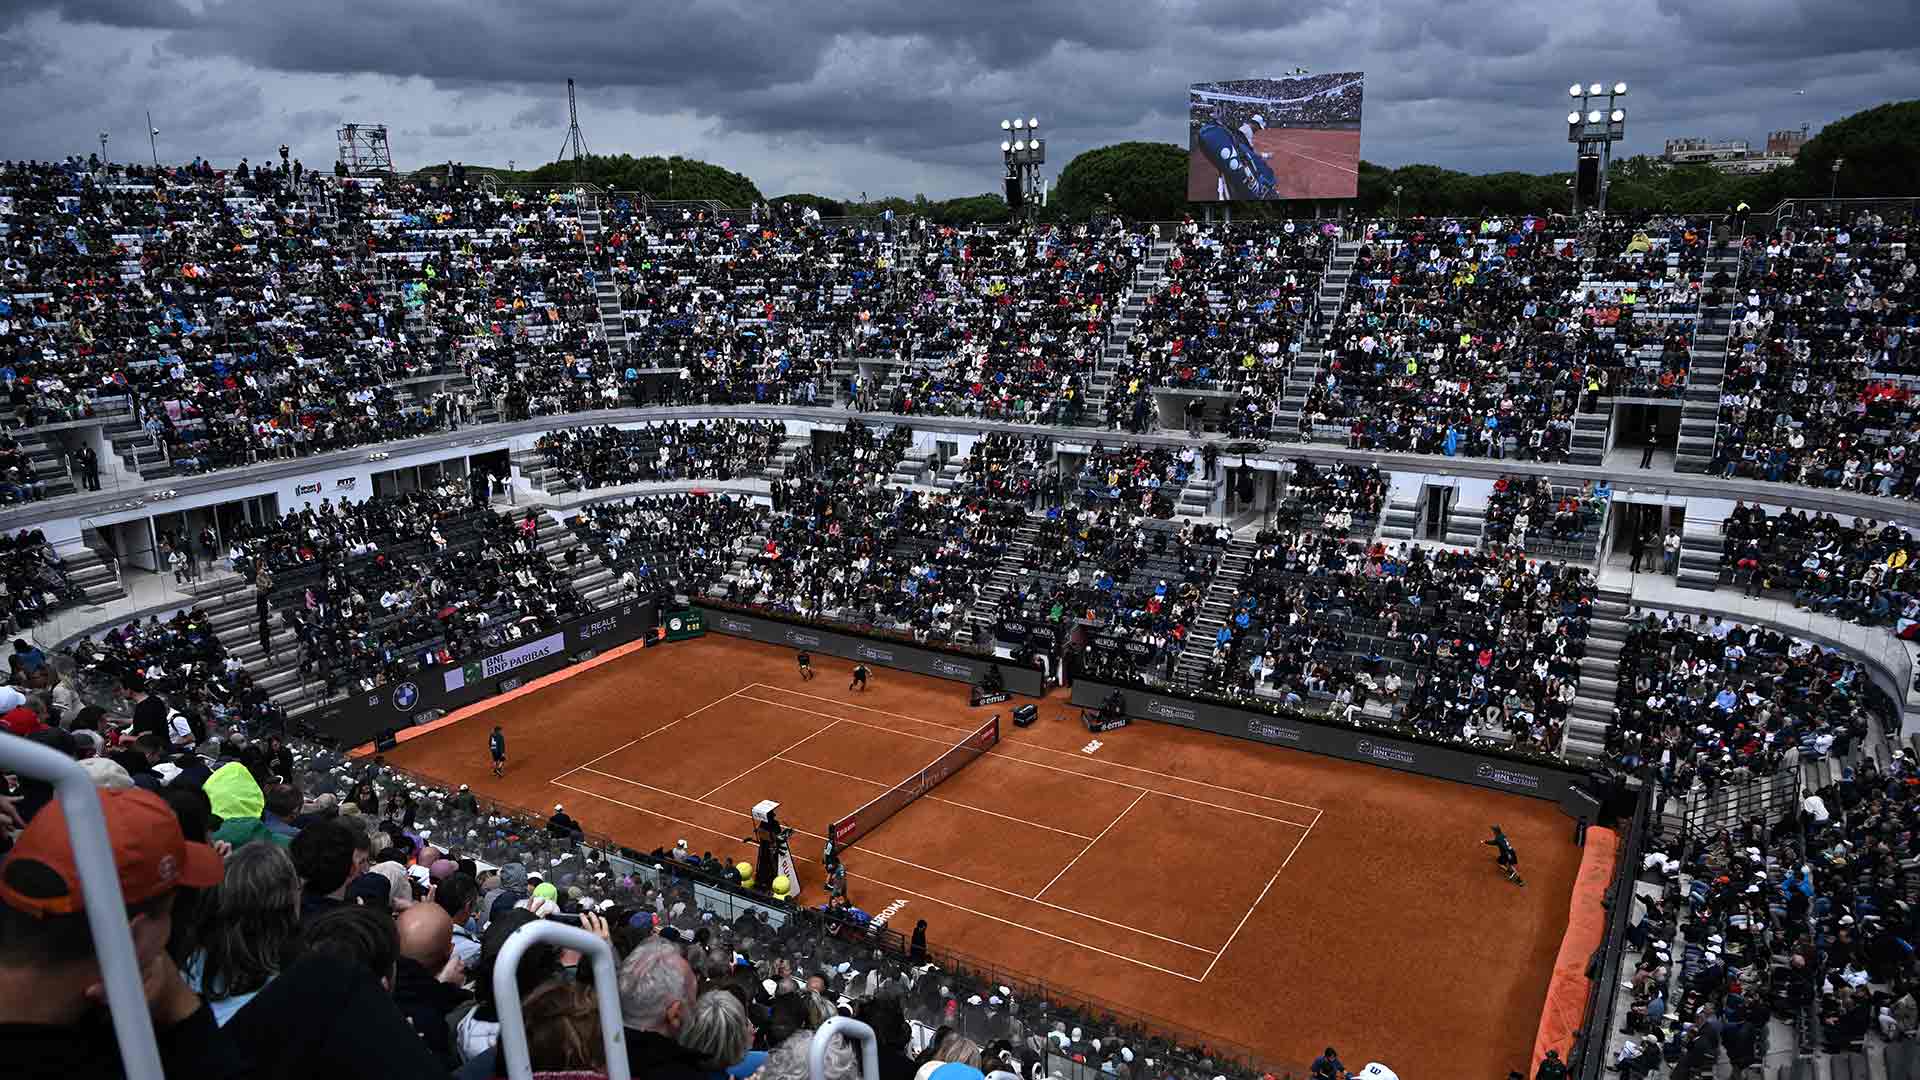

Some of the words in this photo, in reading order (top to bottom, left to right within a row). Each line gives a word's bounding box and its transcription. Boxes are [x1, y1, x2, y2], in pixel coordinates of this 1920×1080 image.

[591, 616, 616, 631] REALE
[486, 654, 505, 668] BNL
[487, 662, 508, 676] BNP
[510, 646, 550, 668] PARIBAS
[986, 695, 1005, 704] emu
[1107, 720, 1126, 730] emu
[876, 899, 910, 925] ROMA
